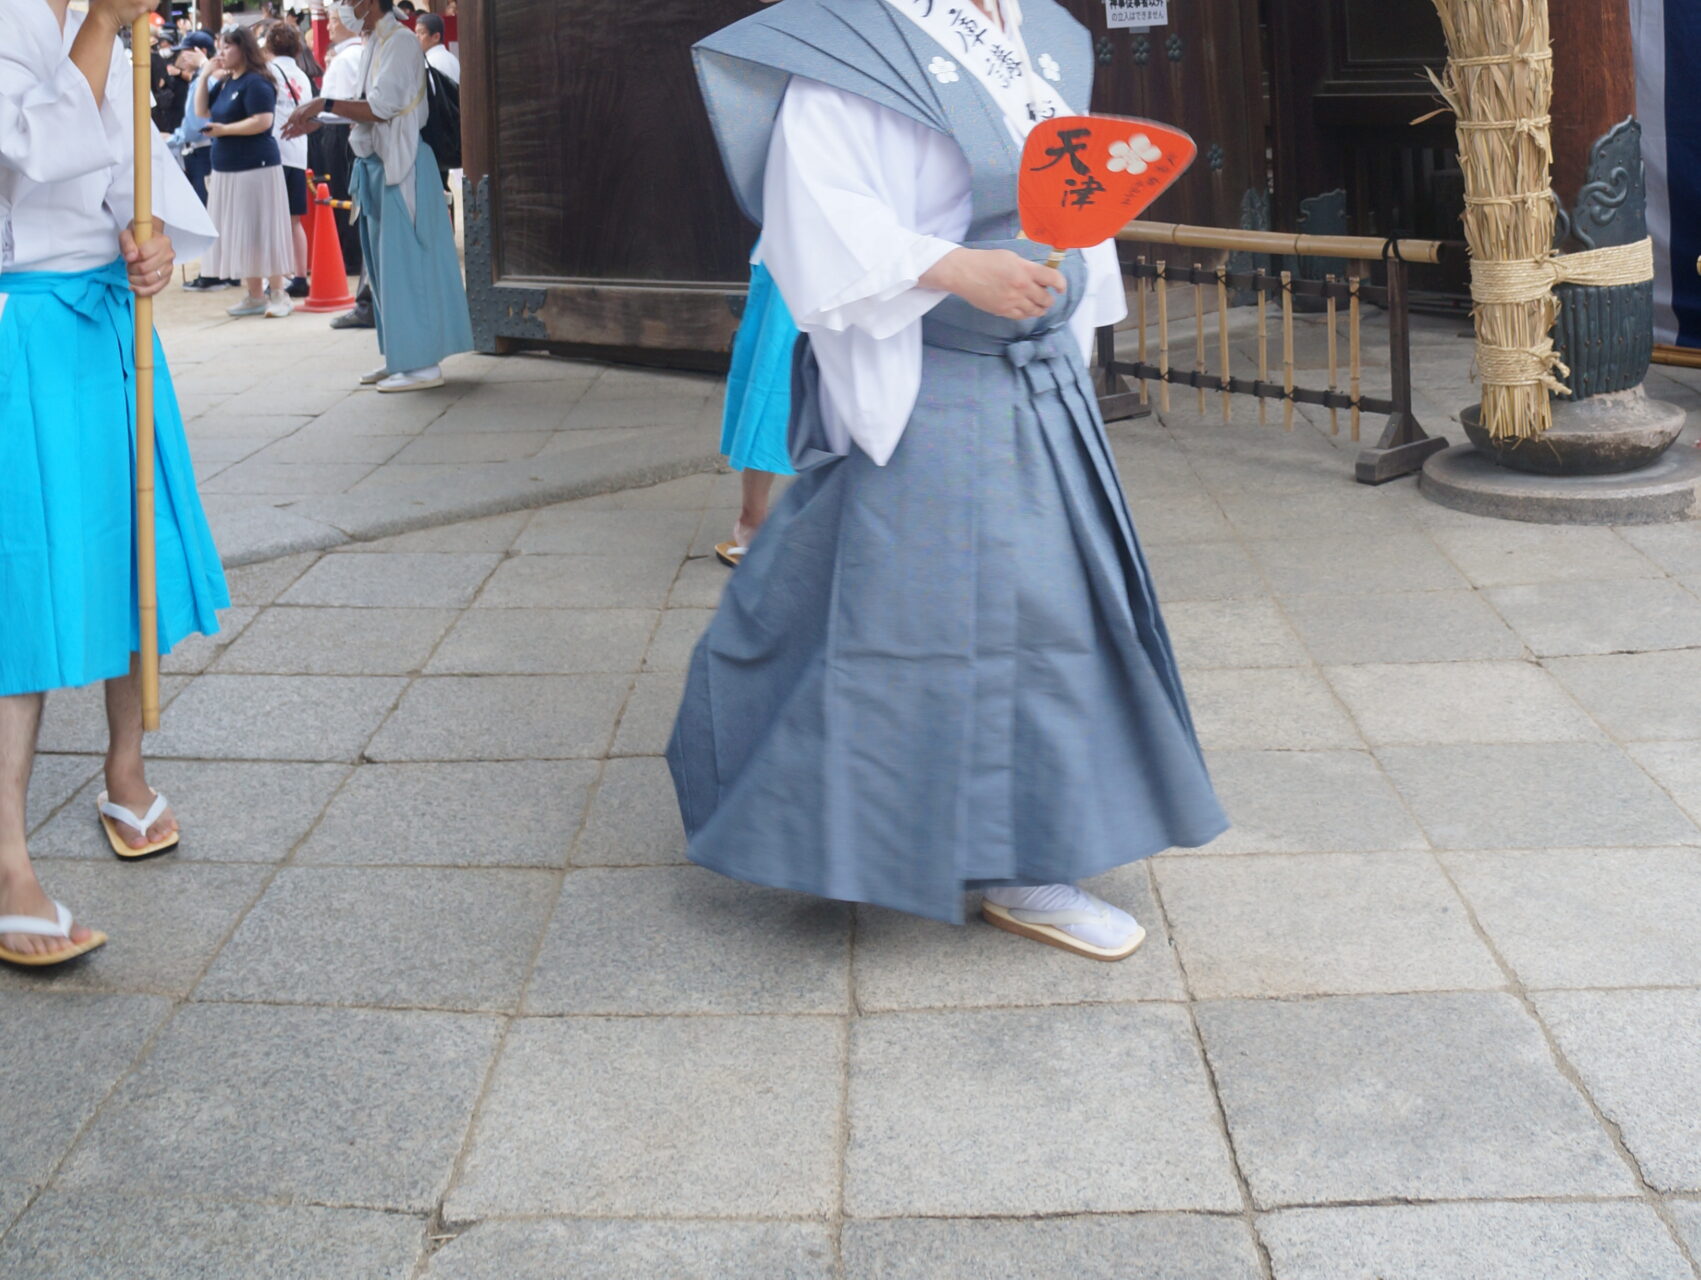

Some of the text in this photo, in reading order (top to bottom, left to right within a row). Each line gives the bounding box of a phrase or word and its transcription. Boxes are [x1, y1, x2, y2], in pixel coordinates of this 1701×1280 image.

[1111, 10, 1164, 22] の立入はできません
[1029, 128, 1107, 212] 天津
